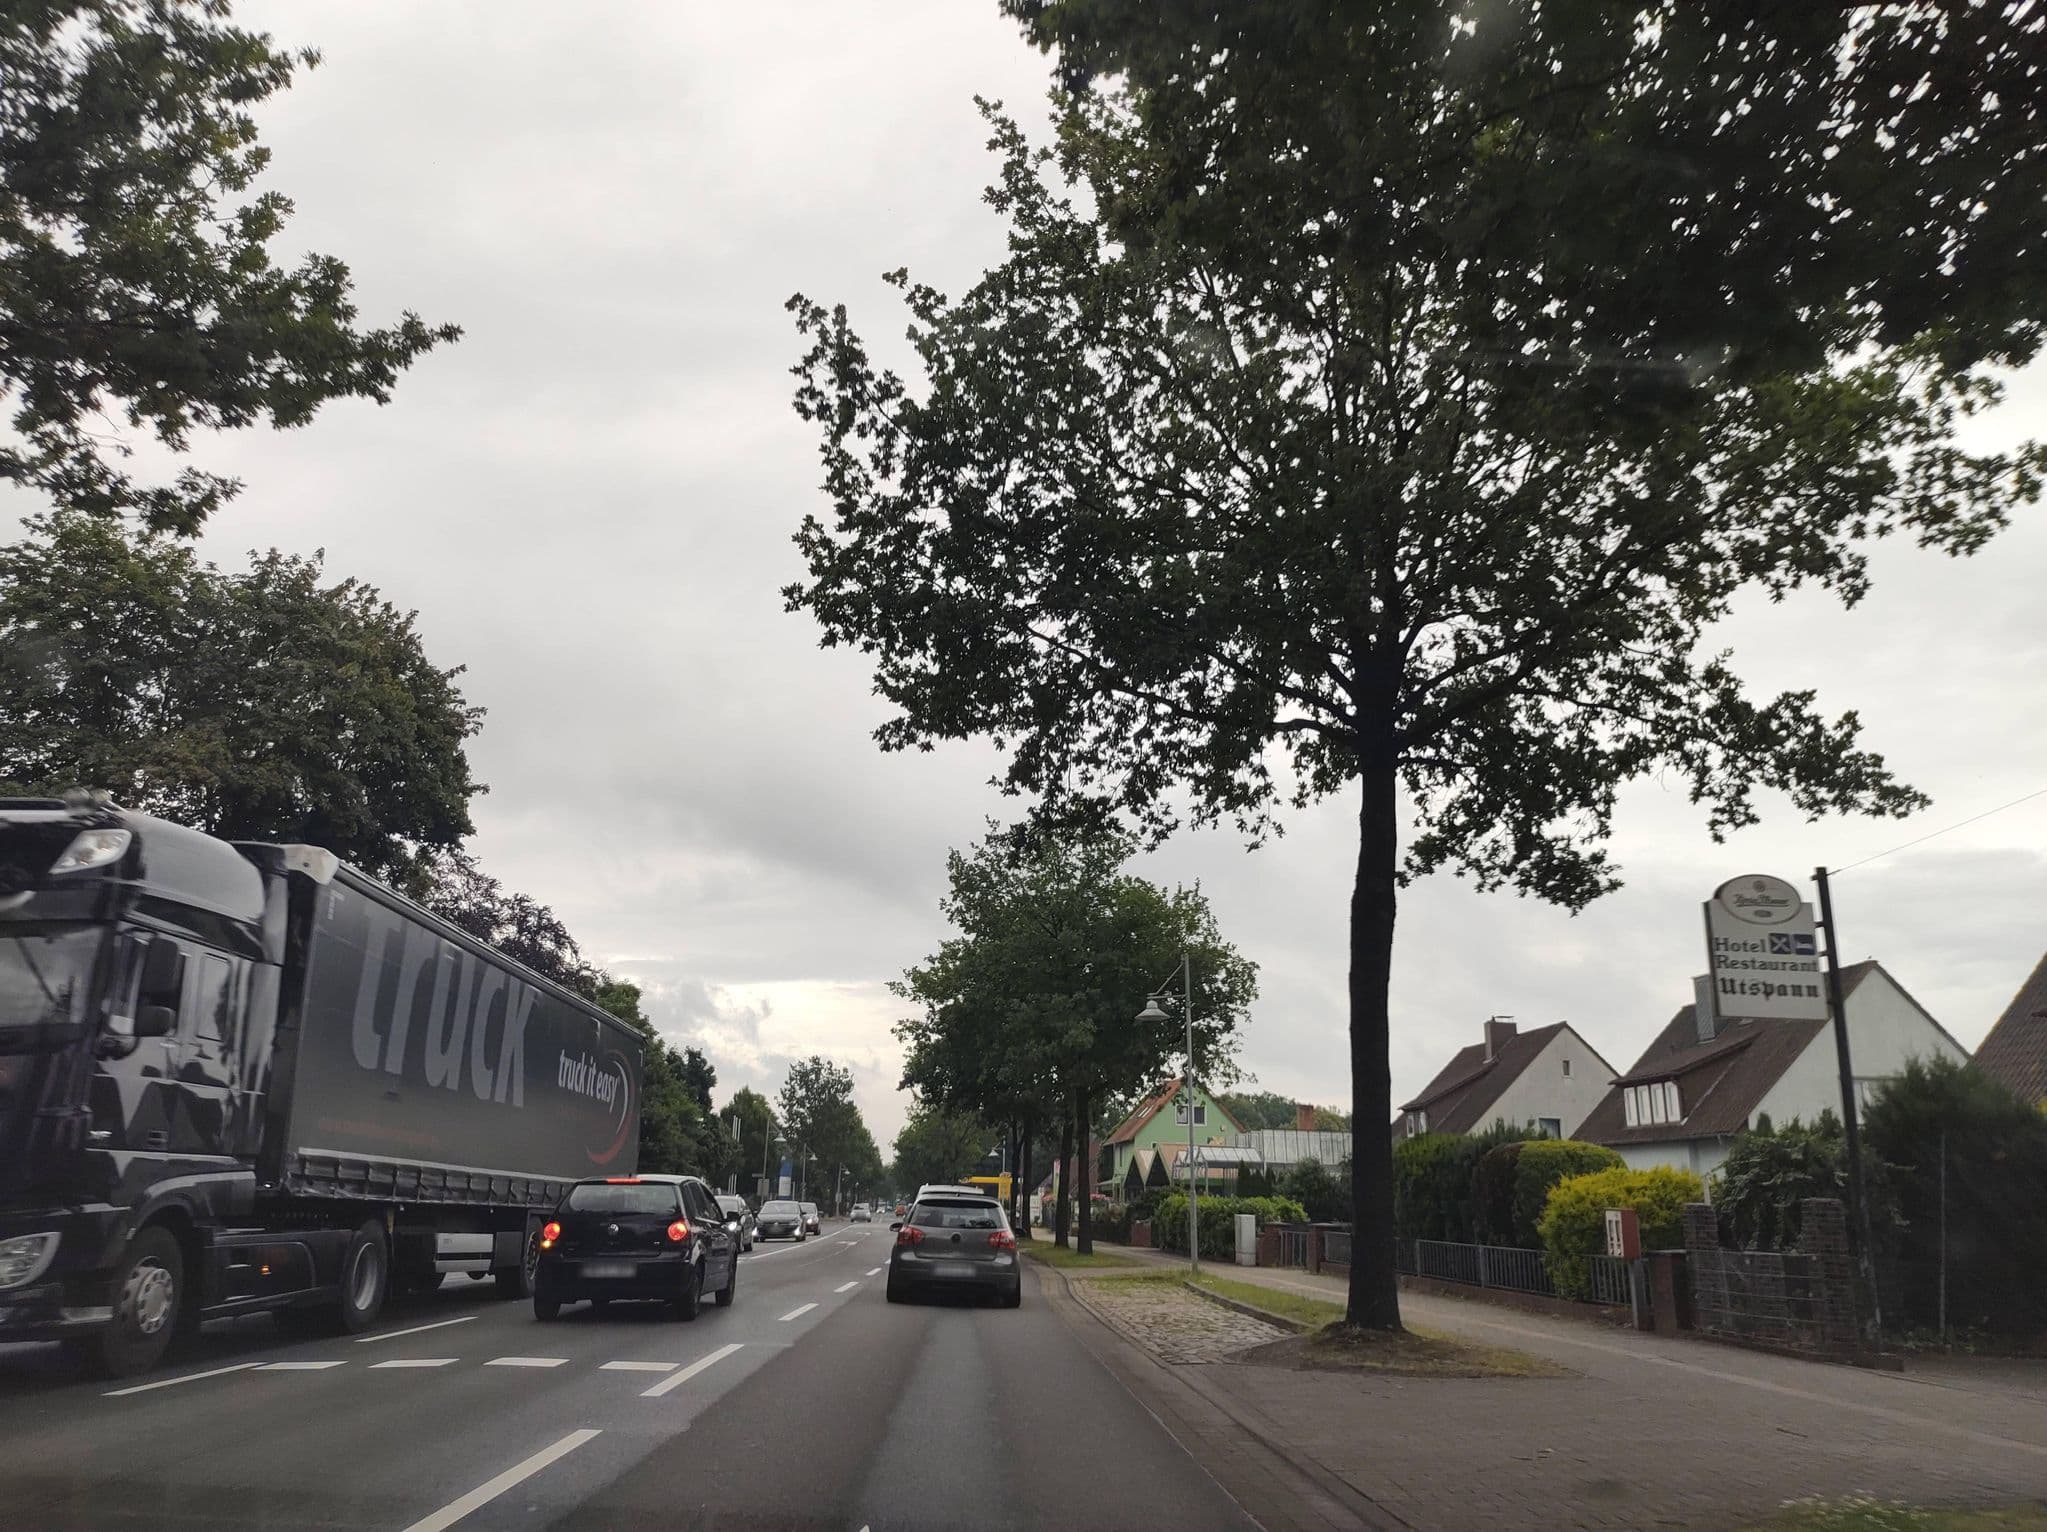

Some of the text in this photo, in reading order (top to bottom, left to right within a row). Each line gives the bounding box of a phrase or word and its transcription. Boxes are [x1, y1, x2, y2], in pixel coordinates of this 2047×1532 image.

[1713, 936, 1766, 953] Hotel
[1714, 954, 1818, 973] Restaurant
[1719, 977, 1819, 1001] Utspann
[352, 902, 541, 1109] truck
[558, 1049, 619, 1113] truck it easy
